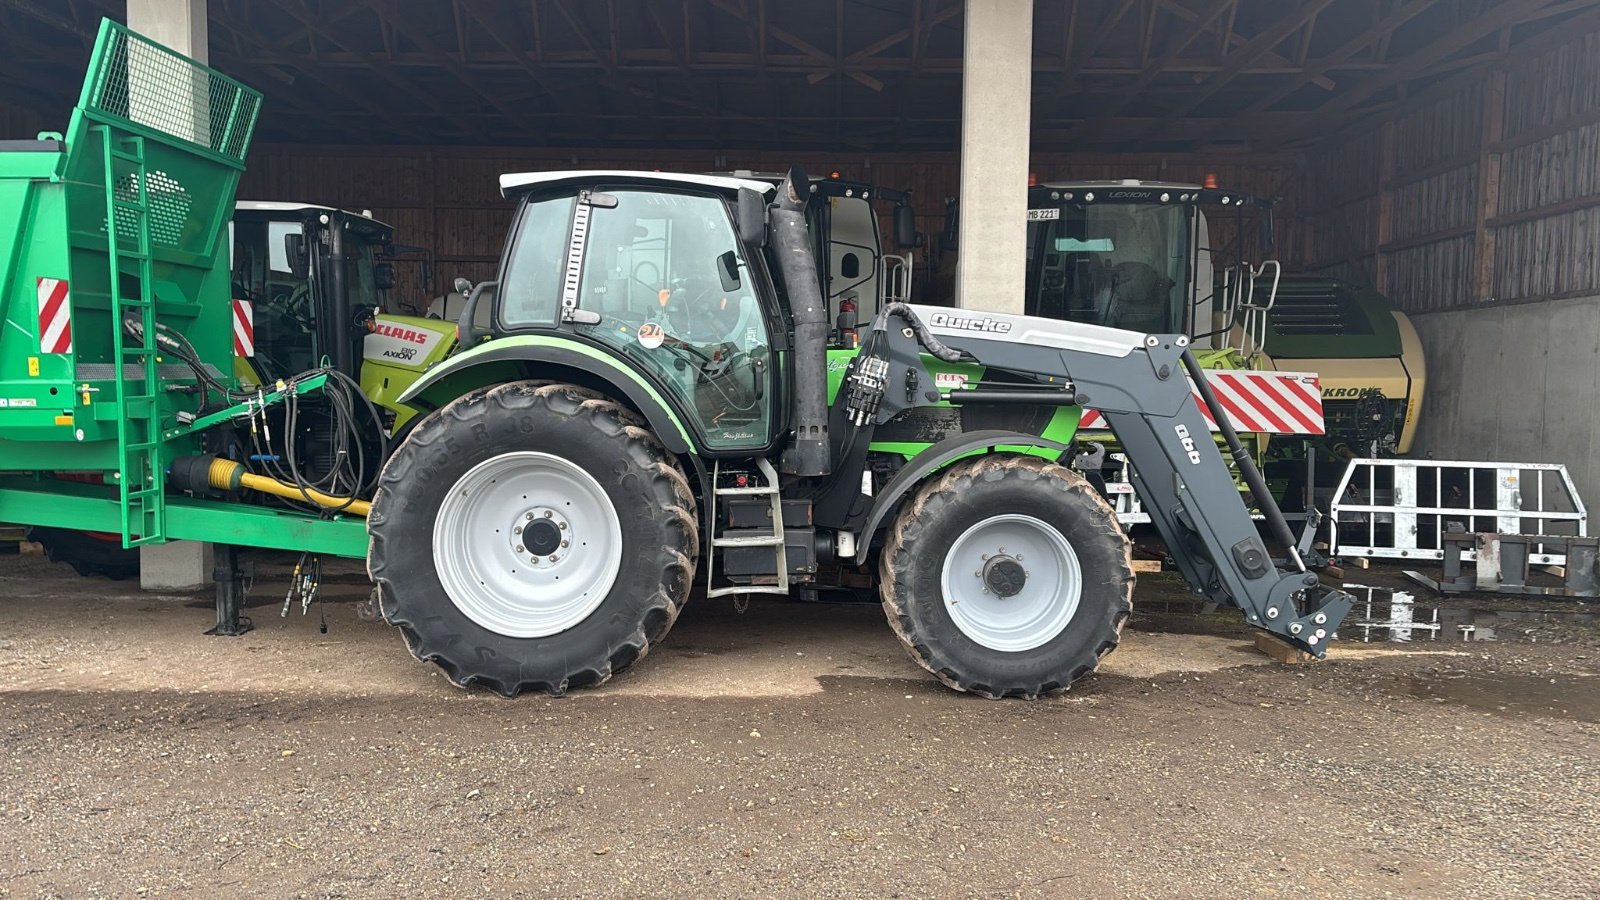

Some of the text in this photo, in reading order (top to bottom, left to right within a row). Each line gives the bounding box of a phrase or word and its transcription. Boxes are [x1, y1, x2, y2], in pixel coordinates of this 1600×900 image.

[1039, 209, 1054, 219] 221
[929, 312, 1012, 333] Quicke
[376, 324, 427, 344] CLAAS
[383, 350, 413, 360] AXION
